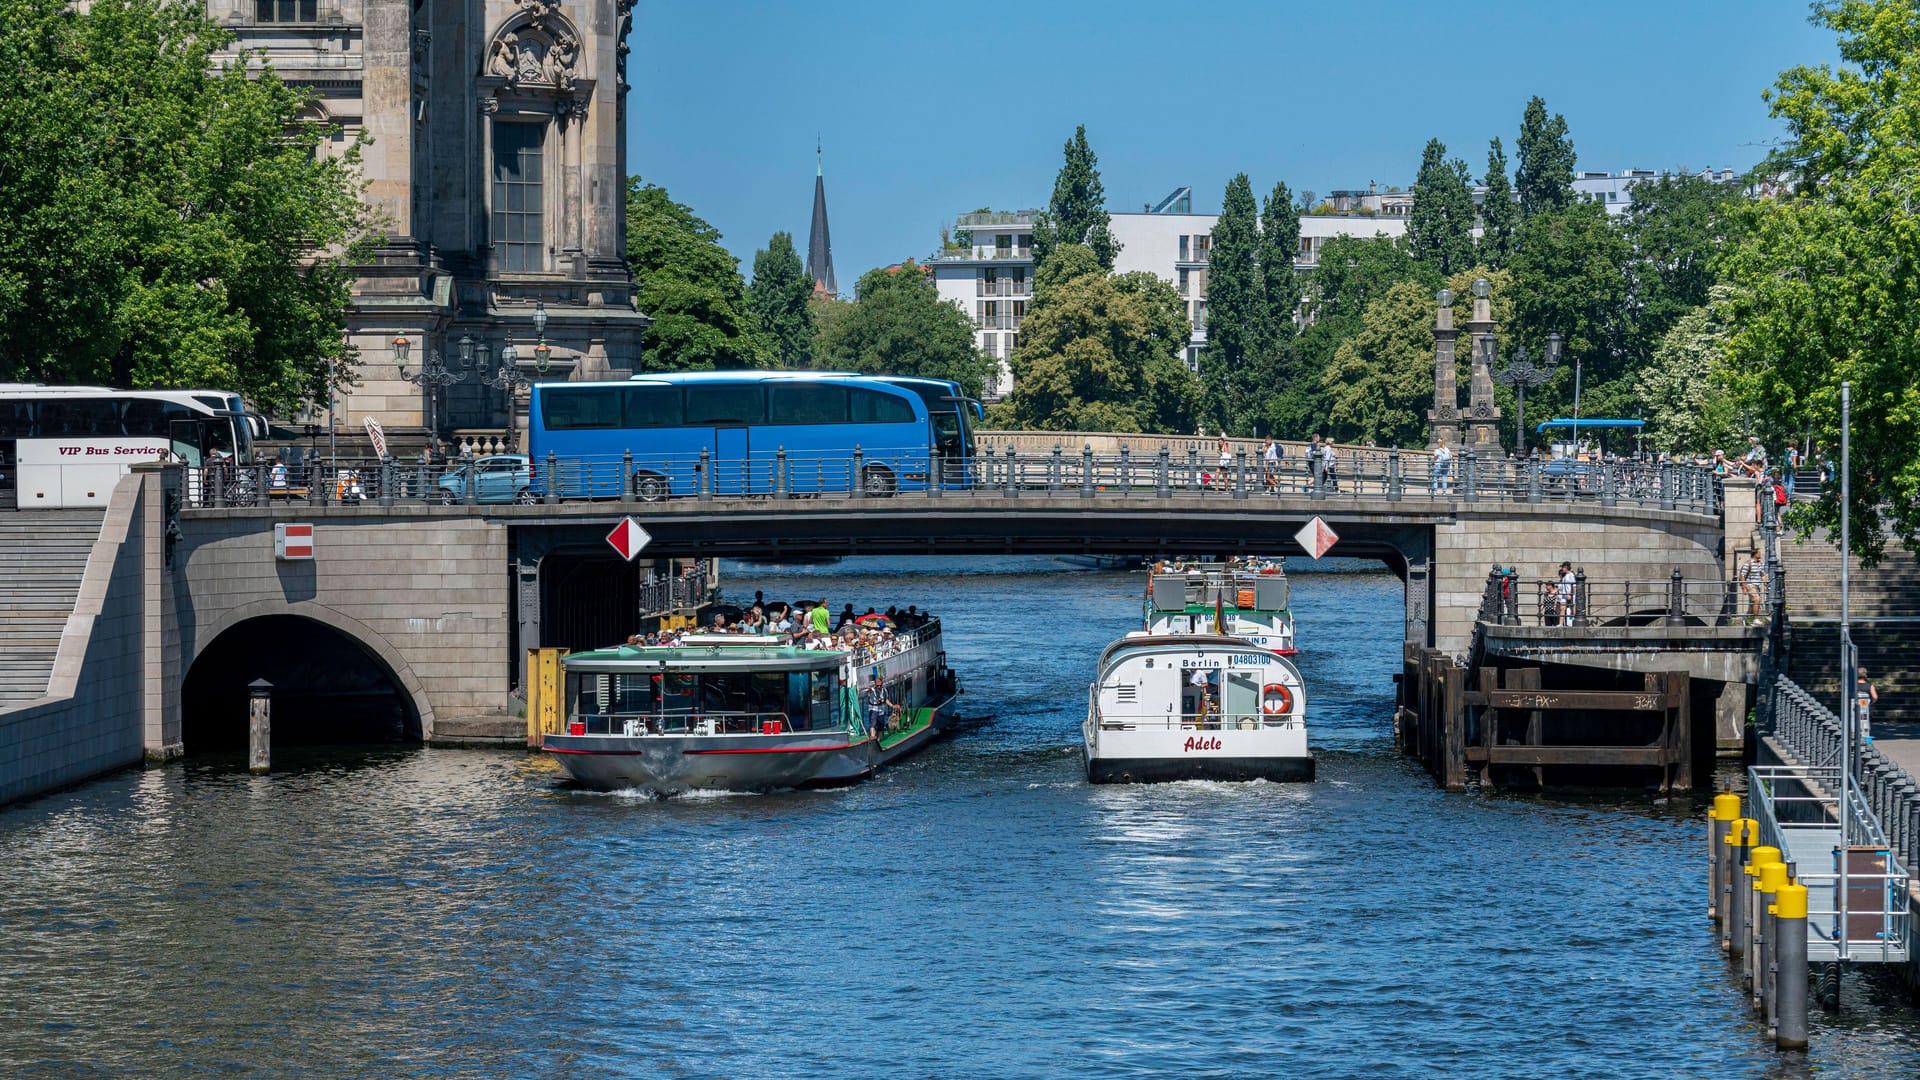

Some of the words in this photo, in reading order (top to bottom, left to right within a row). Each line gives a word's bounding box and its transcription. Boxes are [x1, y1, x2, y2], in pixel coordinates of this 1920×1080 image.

[59, 447, 81, 455] VIP
[85, 447, 110, 455] Bus
[114, 446, 165, 455] Service
[1182, 659, 1220, 667] Berlin
[1233, 655, 1271, 665] 04803100
[1183, 736, 1222, 752] Adele
